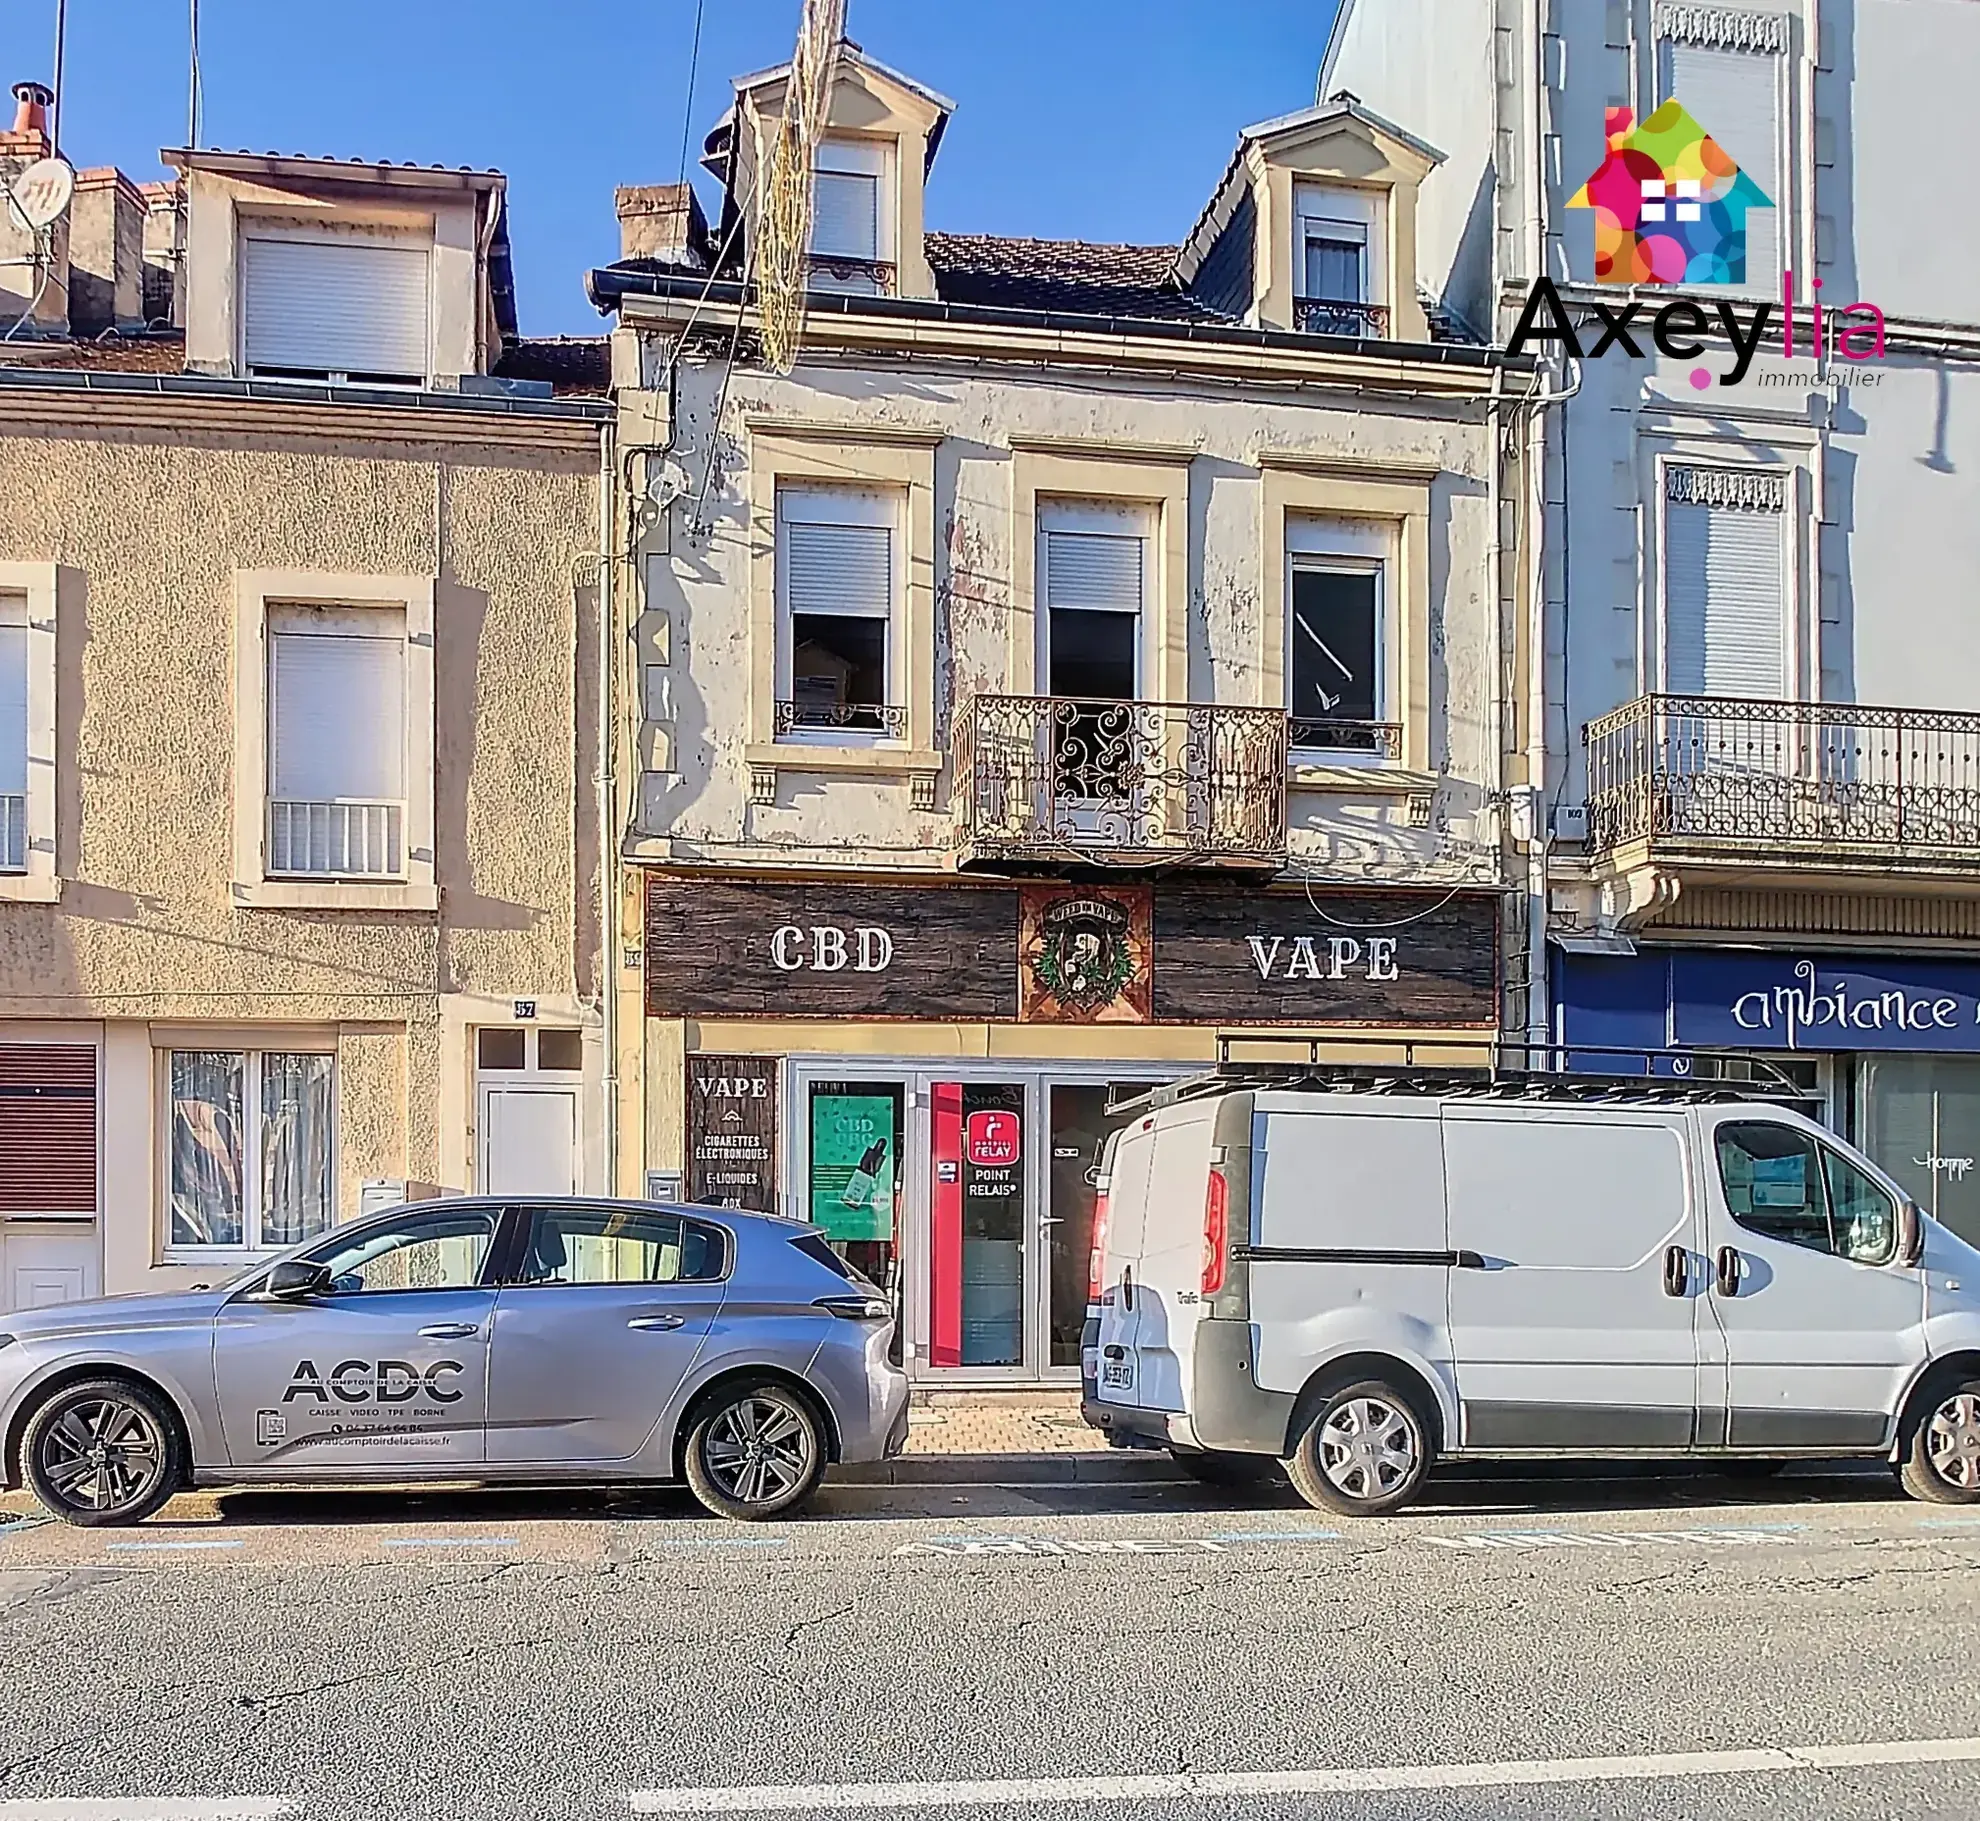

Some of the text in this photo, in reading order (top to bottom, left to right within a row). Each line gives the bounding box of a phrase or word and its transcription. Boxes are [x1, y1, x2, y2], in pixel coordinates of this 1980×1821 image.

[769, 925, 895, 973] CBD
[1244, 935, 1399, 981] VAPE
[515, 1002, 534, 1016] 57
[1731, 960, 1958, 1050] ambiance
[696, 1077, 768, 1098] VAPE
[835, 1119, 874, 1132] CBD
[704, 1135, 760, 1147] CIGARETTES
[695, 1146, 769, 1160] ÉLECTRONIQUES
[706, 1172, 758, 1185] E-LIQUIDES
[975, 1169, 1011, 1181] POINT
[281, 1359, 465, 1403] ACDC
[308, 1408, 342, 1417] CAISSE
[387, 1408, 405, 1417] TPE
[413, 1408, 446, 1417] BORNE
